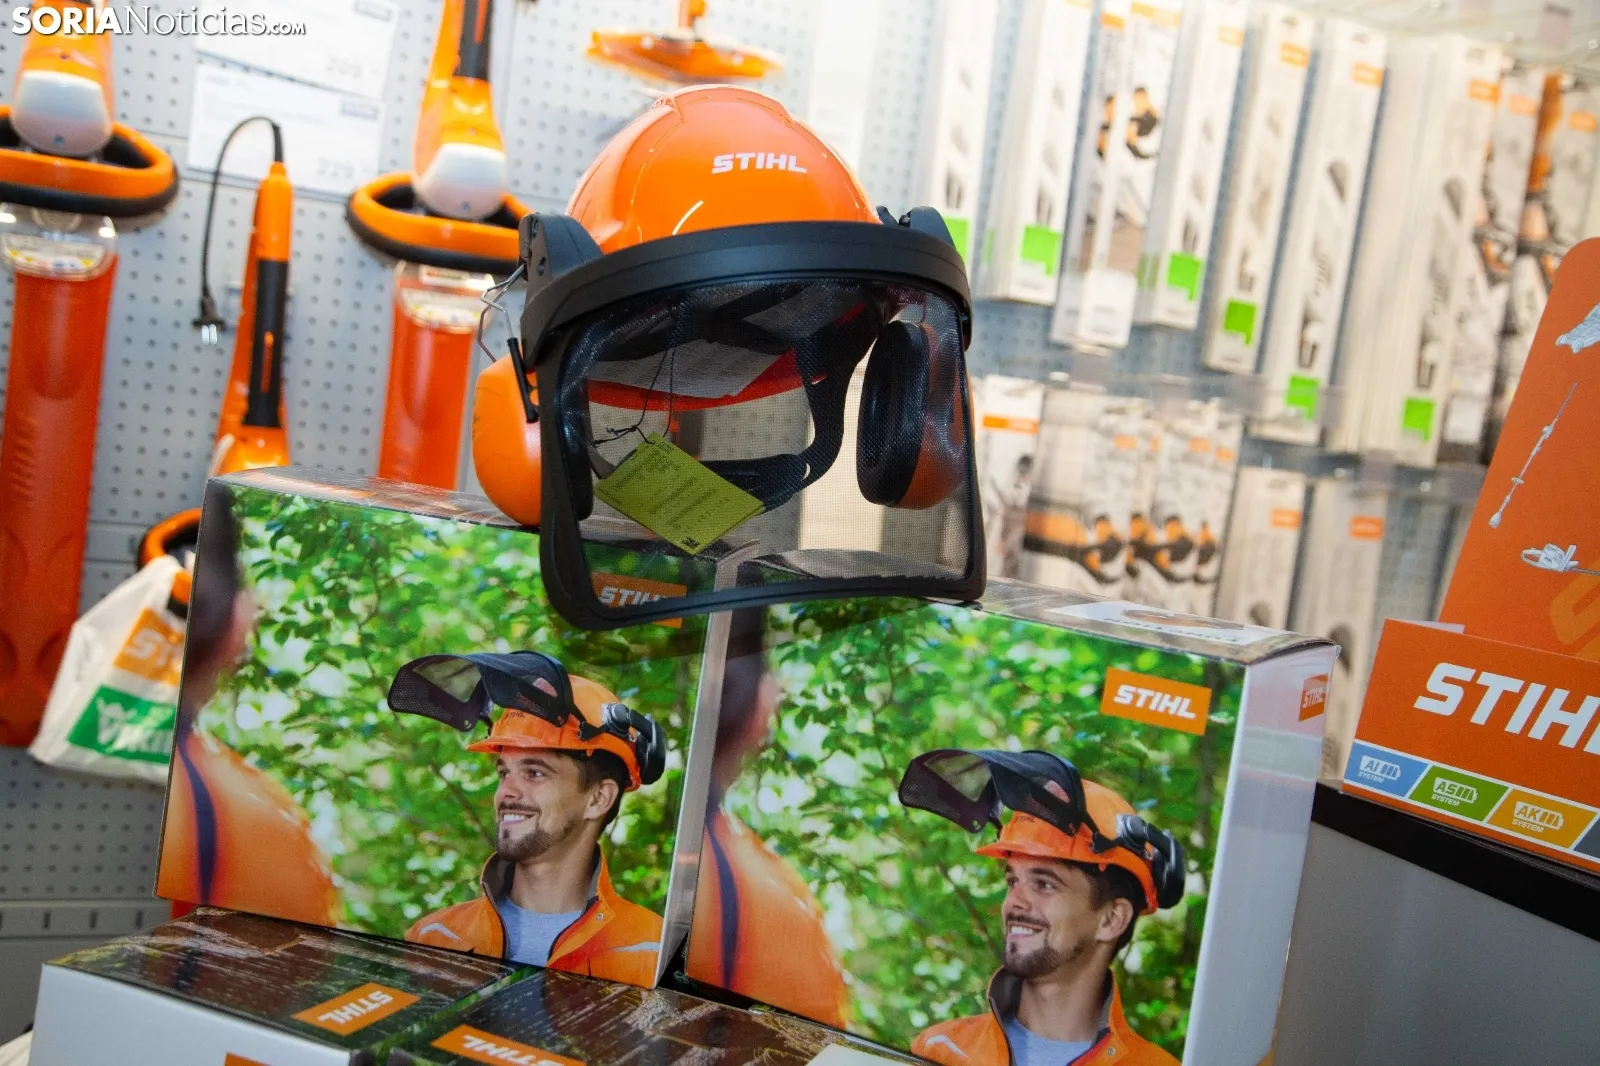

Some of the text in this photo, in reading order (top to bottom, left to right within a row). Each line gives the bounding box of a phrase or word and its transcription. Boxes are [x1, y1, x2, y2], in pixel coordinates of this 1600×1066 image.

[711, 151, 808, 174] STIHL
[599, 585, 665, 606] STIH
[1113, 684, 1197, 720] STIHL
[1364, 759, 1380, 772] AI
[1357, 770, 1385, 783] SYSTEM
[1437, 779, 1455, 793] AS
[1431, 793, 1461, 807] SYSTEM
[1516, 804, 1543, 820] AK
[1512, 818, 1545, 833] SYSTEM
[317, 990, 394, 1024] STIHL
